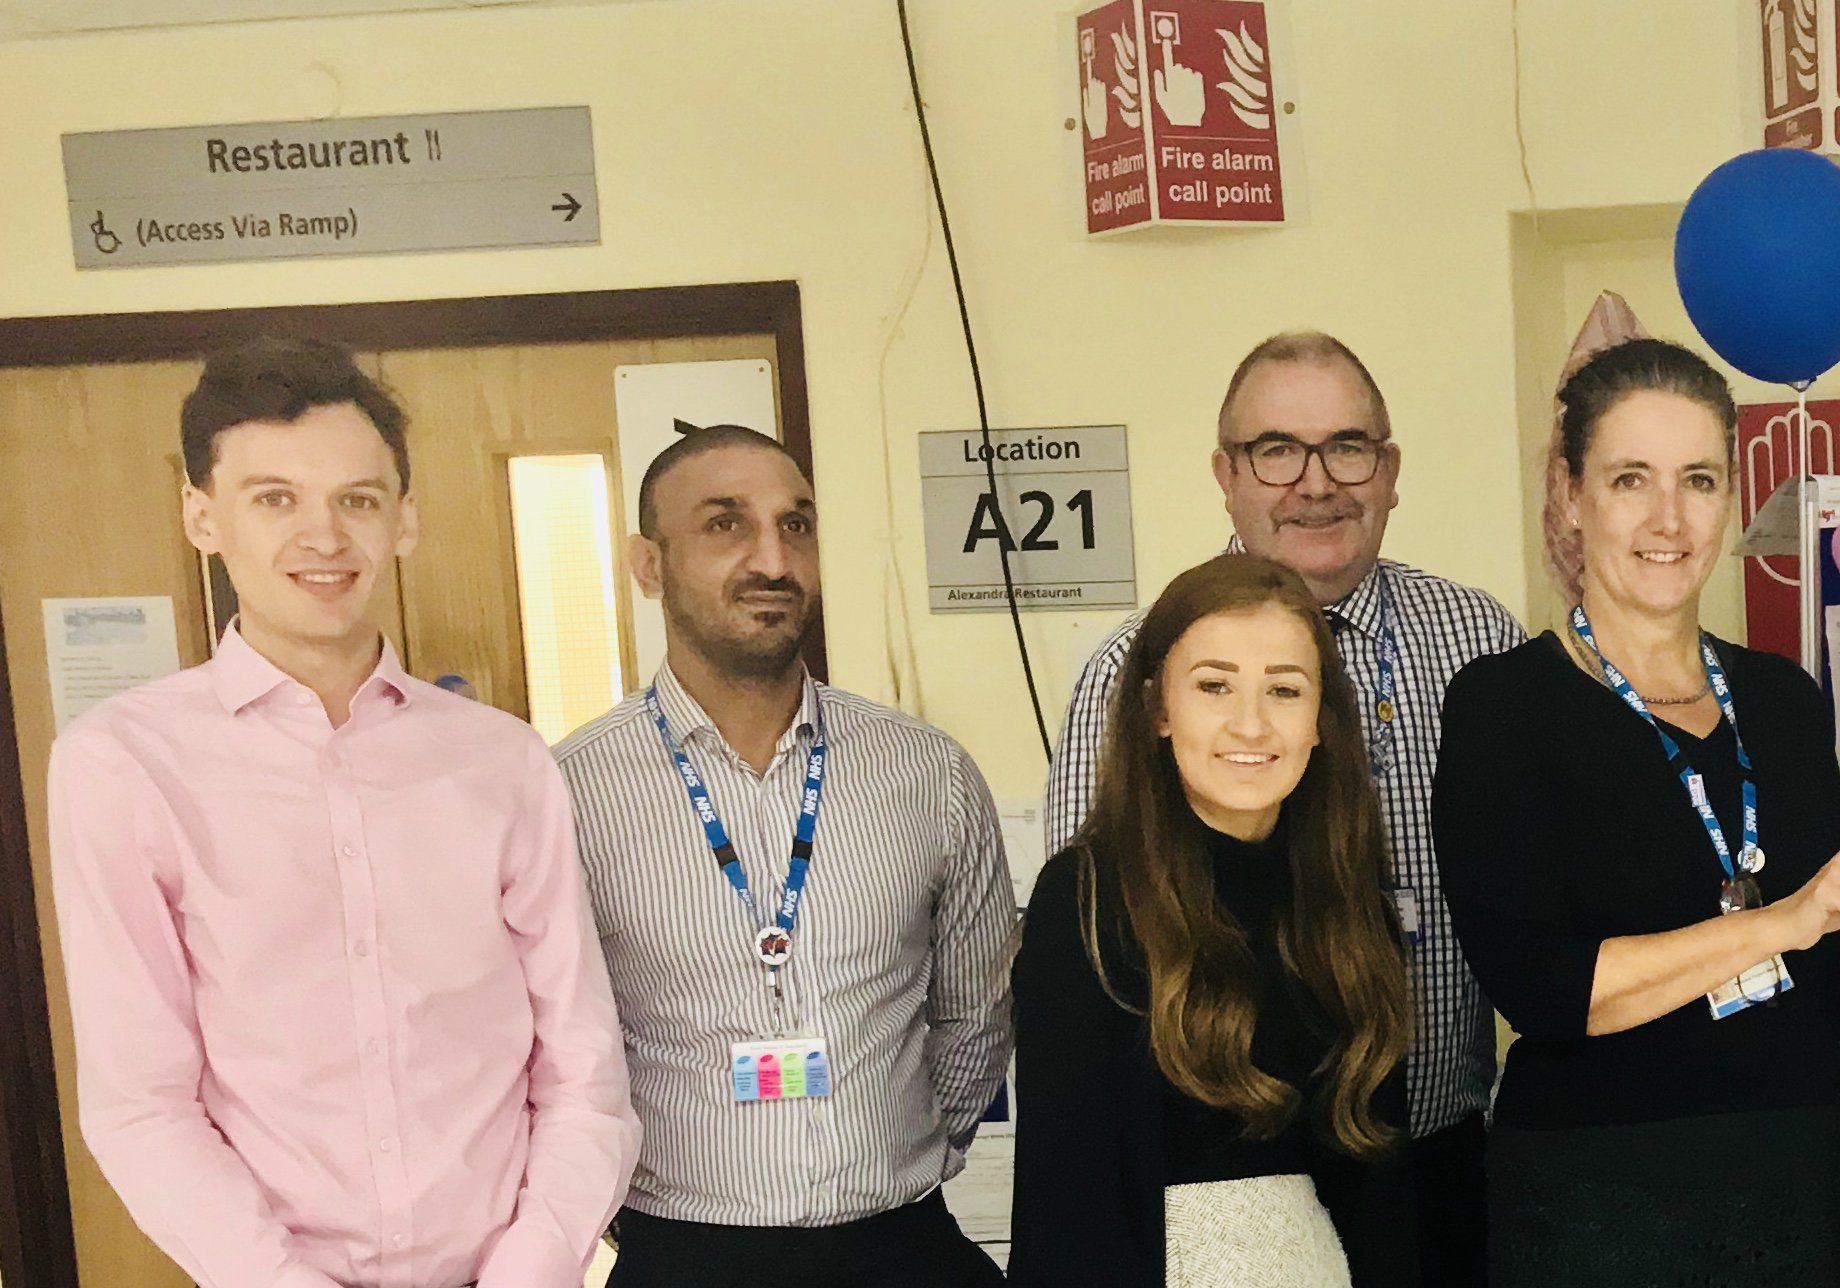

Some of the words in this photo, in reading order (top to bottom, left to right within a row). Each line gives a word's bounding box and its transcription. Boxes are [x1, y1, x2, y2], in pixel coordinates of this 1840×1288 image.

[205, 129, 412, 175] Restaurant
[1161, 146, 1206, 169] Fire
[1211, 147, 1274, 172] alarm
[1086, 160, 1110, 183] Fire
[1112, 151, 1145, 177] alarm
[1092, 192, 1113, 216] call
[1114, 184, 1145, 214] point
[1168, 181, 1208, 203] call
[1215, 183, 1273, 208] point
[135, 213, 225, 248] (Access
[232, 213, 272, 240] Via
[279, 208, 359, 241] Ramp)
[963, 435, 1081, 463] Location
[962, 489, 1096, 553] A21
[947, 588, 1011, 601] Alexandra
[1014, 587, 1082, 599] Restaurant
[1381, 670, 1392, 698] NHS
[1711, 673, 1728, 696] NHS
[679, 760, 701, 788] NHS
[808, 754, 823, 781] NHS
[694, 795, 717, 824] NHS
[803, 787, 818, 816] NHS
[1710, 828, 1729, 856] NHS
[781, 887, 798, 919] NHS
